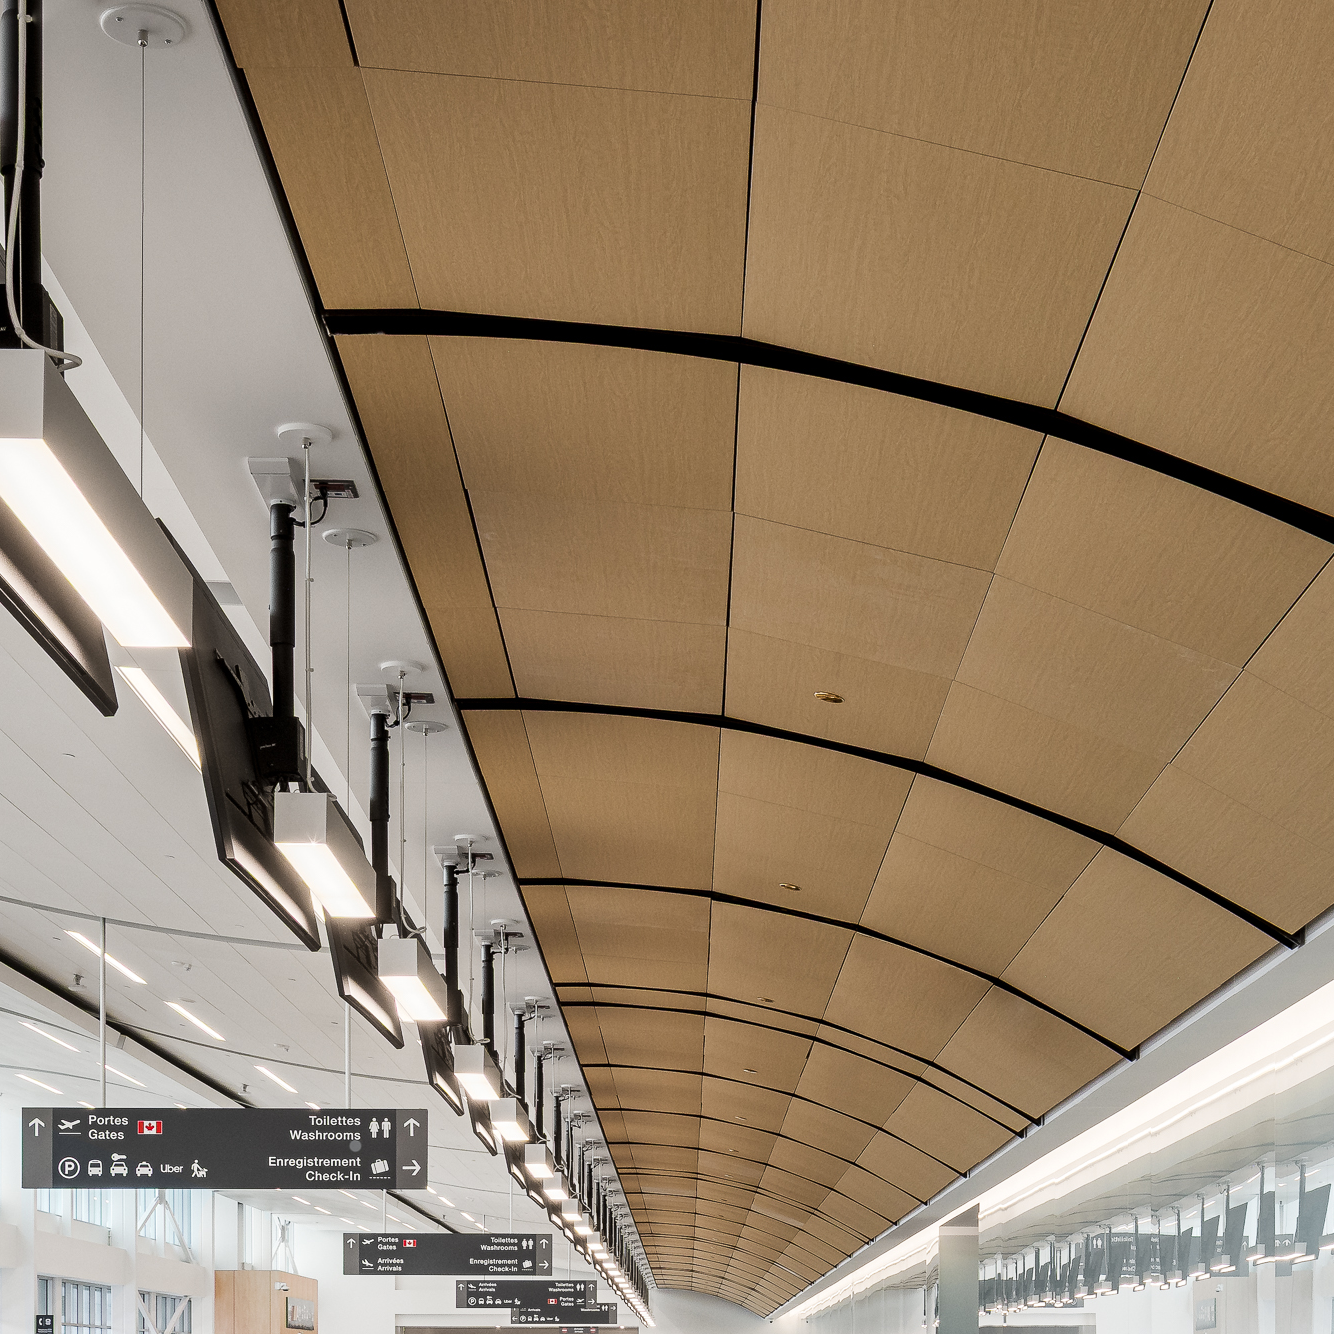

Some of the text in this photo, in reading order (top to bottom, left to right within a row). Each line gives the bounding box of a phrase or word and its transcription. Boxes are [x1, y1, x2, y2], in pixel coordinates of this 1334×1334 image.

[88, 1115, 129, 1126] Portes
[308, 1116, 361, 1126] Toilettes
[88, 1129, 125, 1140] Gates
[289, 1130, 361, 1141] Washrooms
[268, 1156, 361, 1169] Enregistrement
[160, 1164, 184, 1173] Uber
[305, 1171, 361, 1181] Check-In
[469, 1258, 518, 1266] Enregistrement
